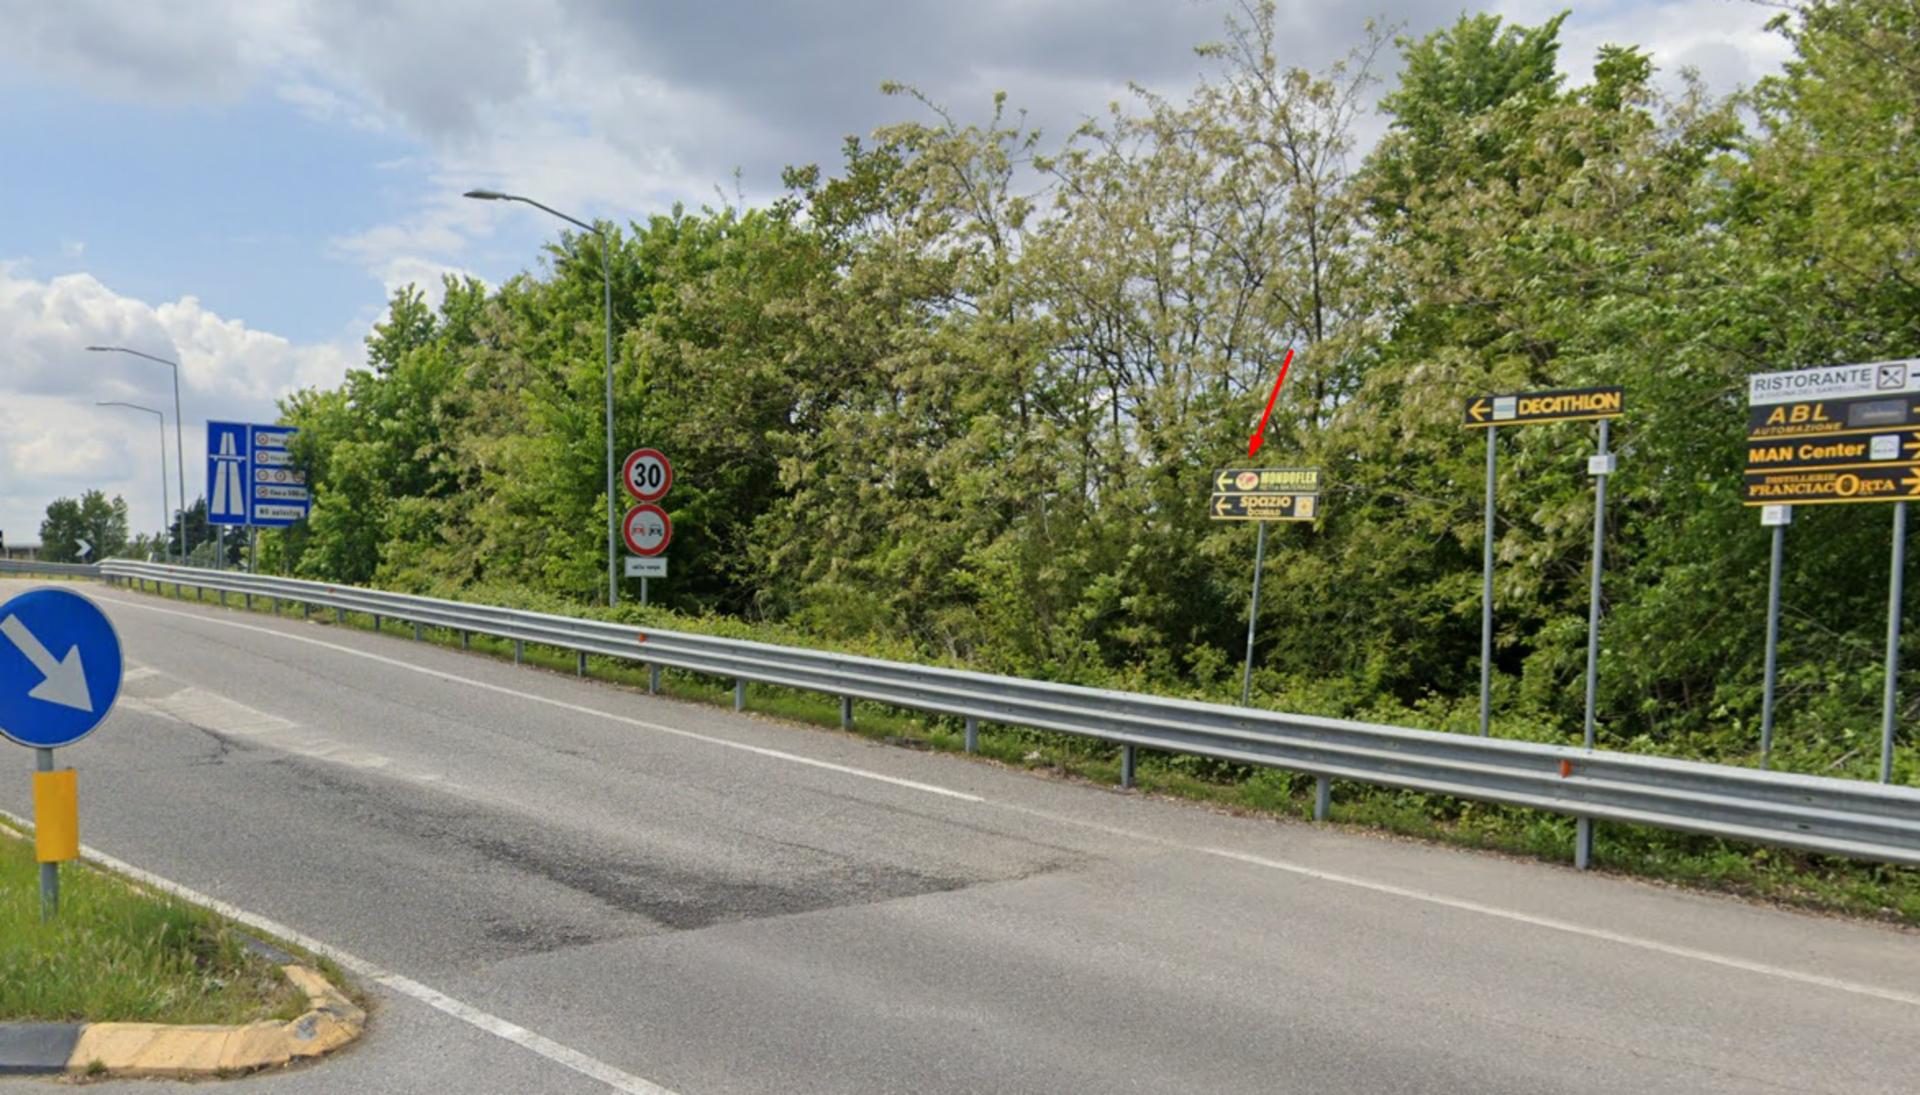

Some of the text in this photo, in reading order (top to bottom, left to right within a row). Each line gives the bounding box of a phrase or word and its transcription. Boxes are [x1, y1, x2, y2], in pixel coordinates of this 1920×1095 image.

[1754, 368, 1872, 391] RISTORANTE
[1519, 392, 1621, 415] DECATHLON
[1766, 403, 1829, 425] ABL
[1753, 422, 1843, 436] AUTOMAZIONE
[1749, 444, 1866, 462] MAN Center
[634, 463, 661, 488] 30
[1750, 474, 1896, 496] FRANCIACORTA
